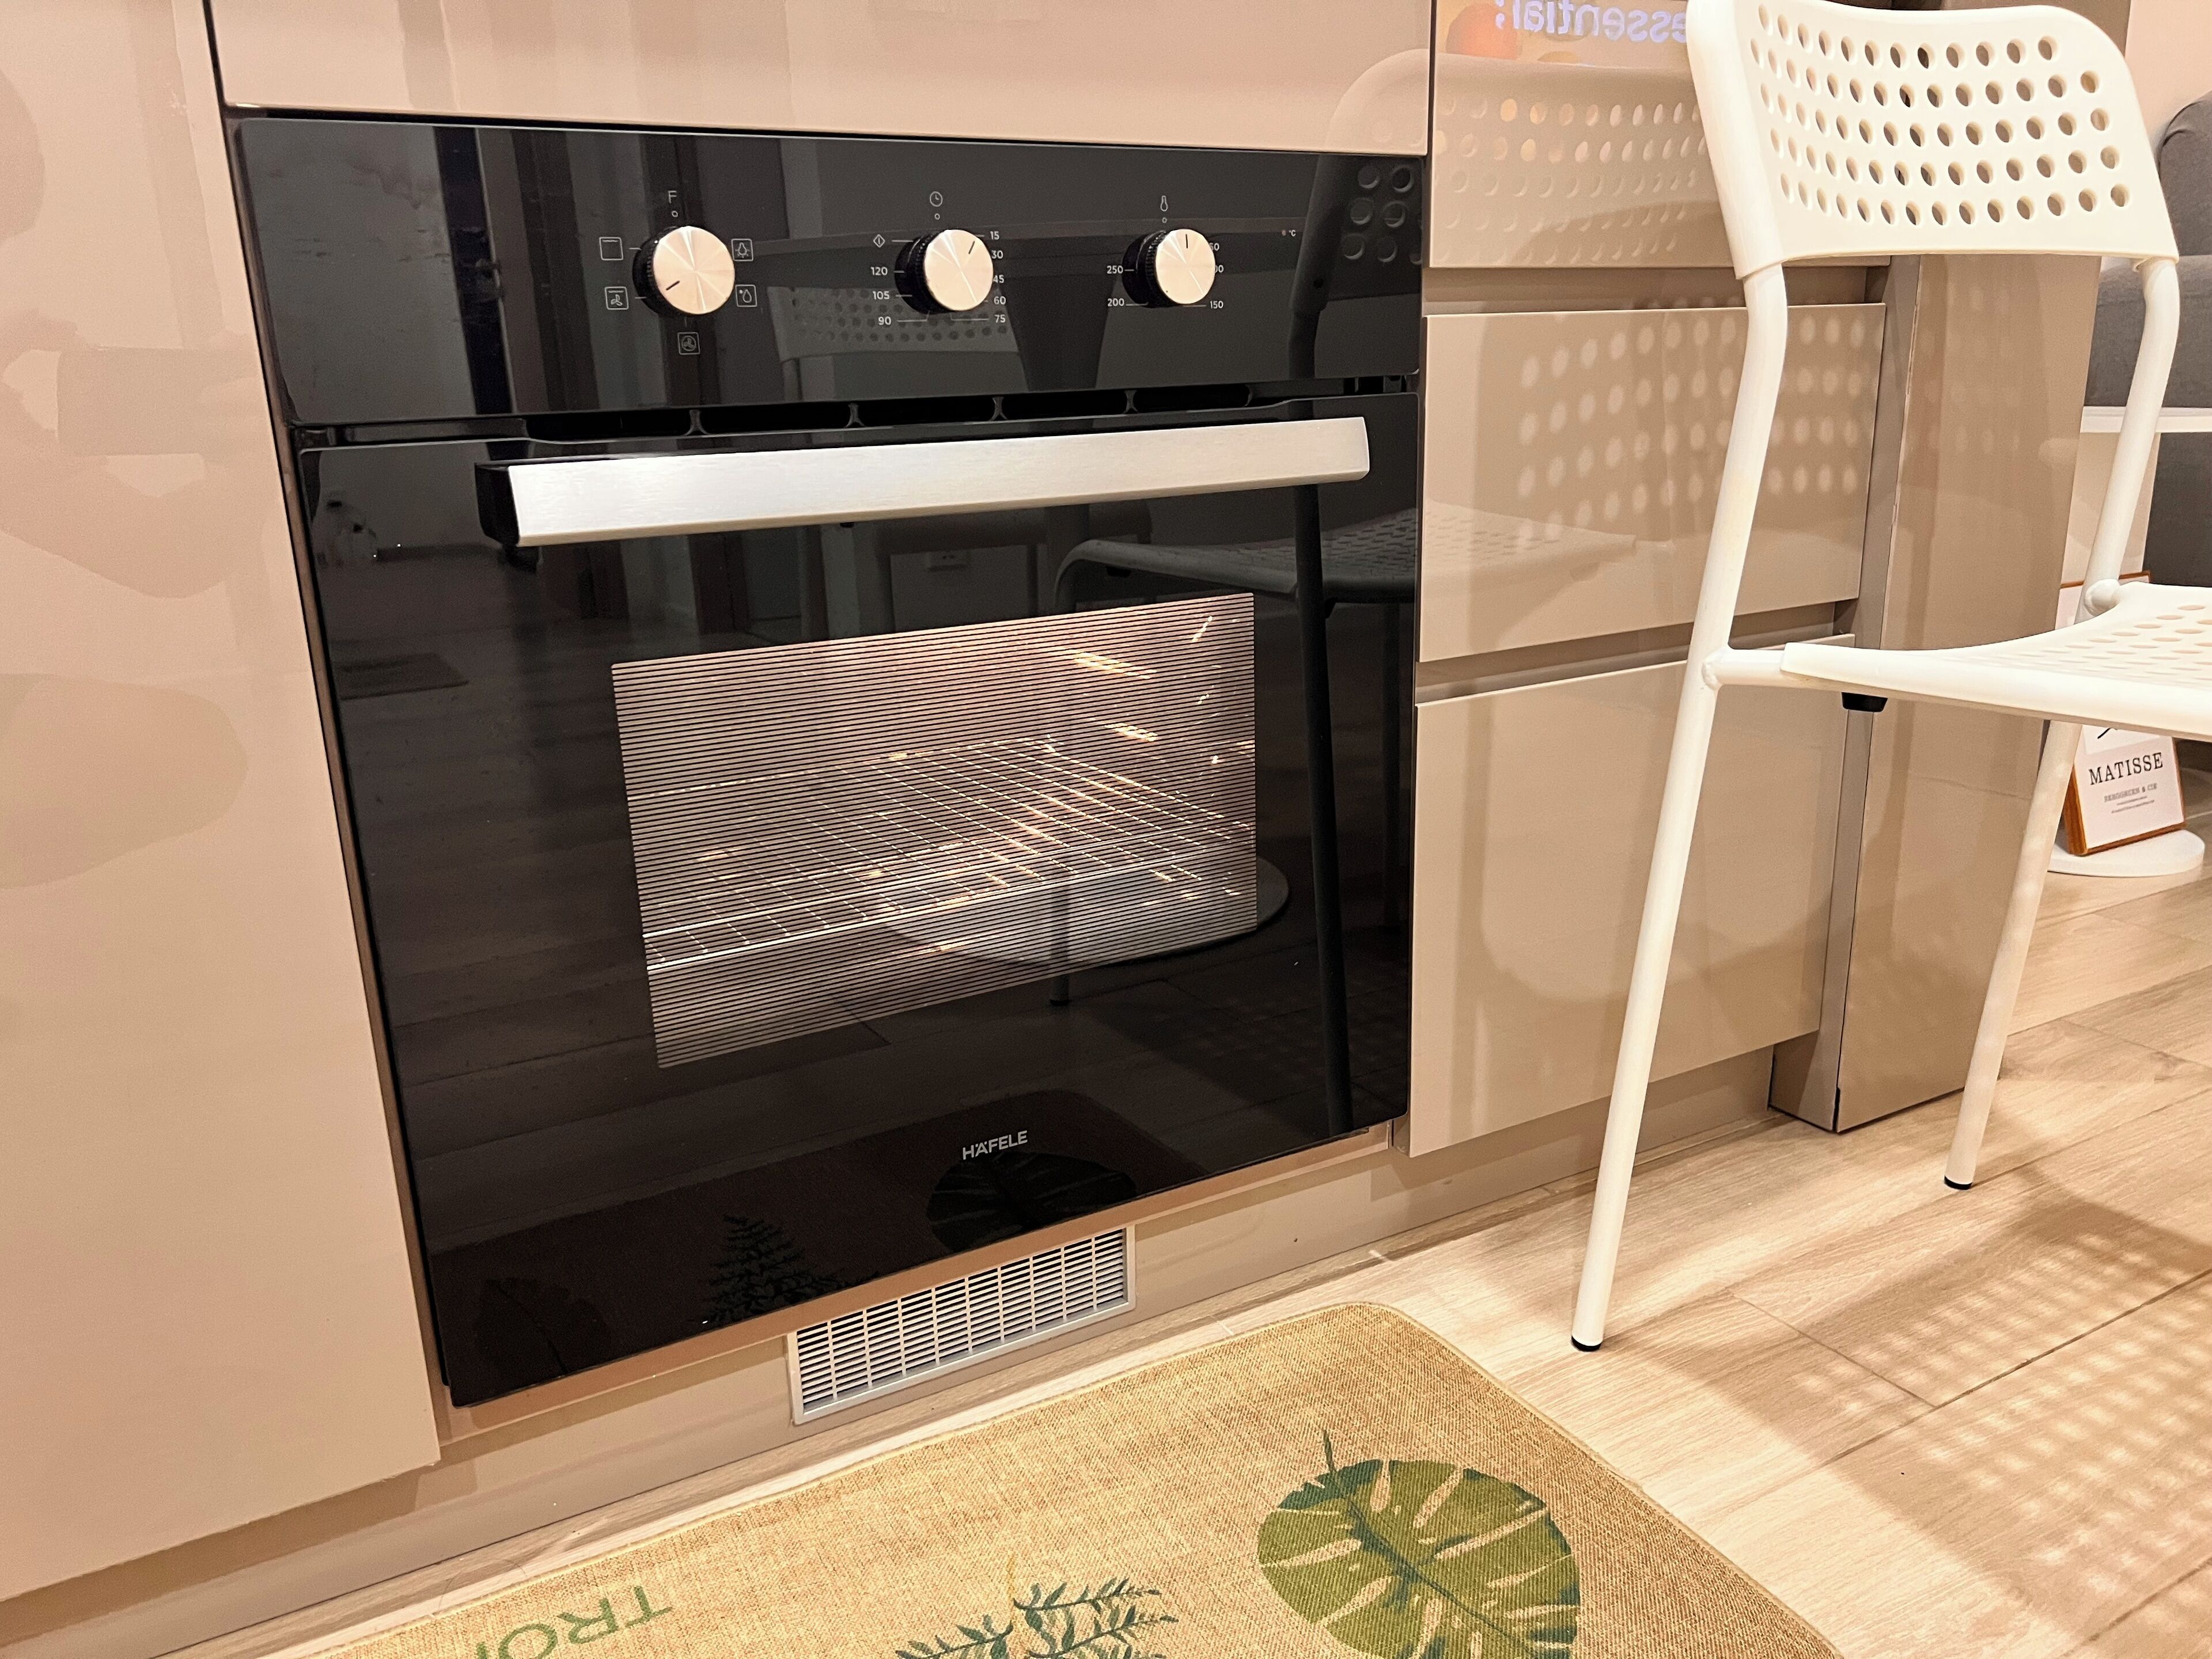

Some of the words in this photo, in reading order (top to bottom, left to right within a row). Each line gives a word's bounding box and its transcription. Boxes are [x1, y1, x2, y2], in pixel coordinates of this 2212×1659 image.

[990, 230, 1000, 240] 15
[991, 249, 1003, 259] 30
[870, 267, 888, 276] 120
[1107, 265, 1123, 274] 250
[993, 274, 1005, 283] 45
[872, 291, 890, 300] 105
[993, 296, 1006, 305] 60
[1107, 298, 1124, 307] 200
[1210, 300, 1224, 309] 150
[878, 316, 892, 325] 90
[994, 314, 1006, 323] 75
[2088, 752, 2164, 786] MATISSE
[962, 1130, 1028, 1161] HÄFELE
